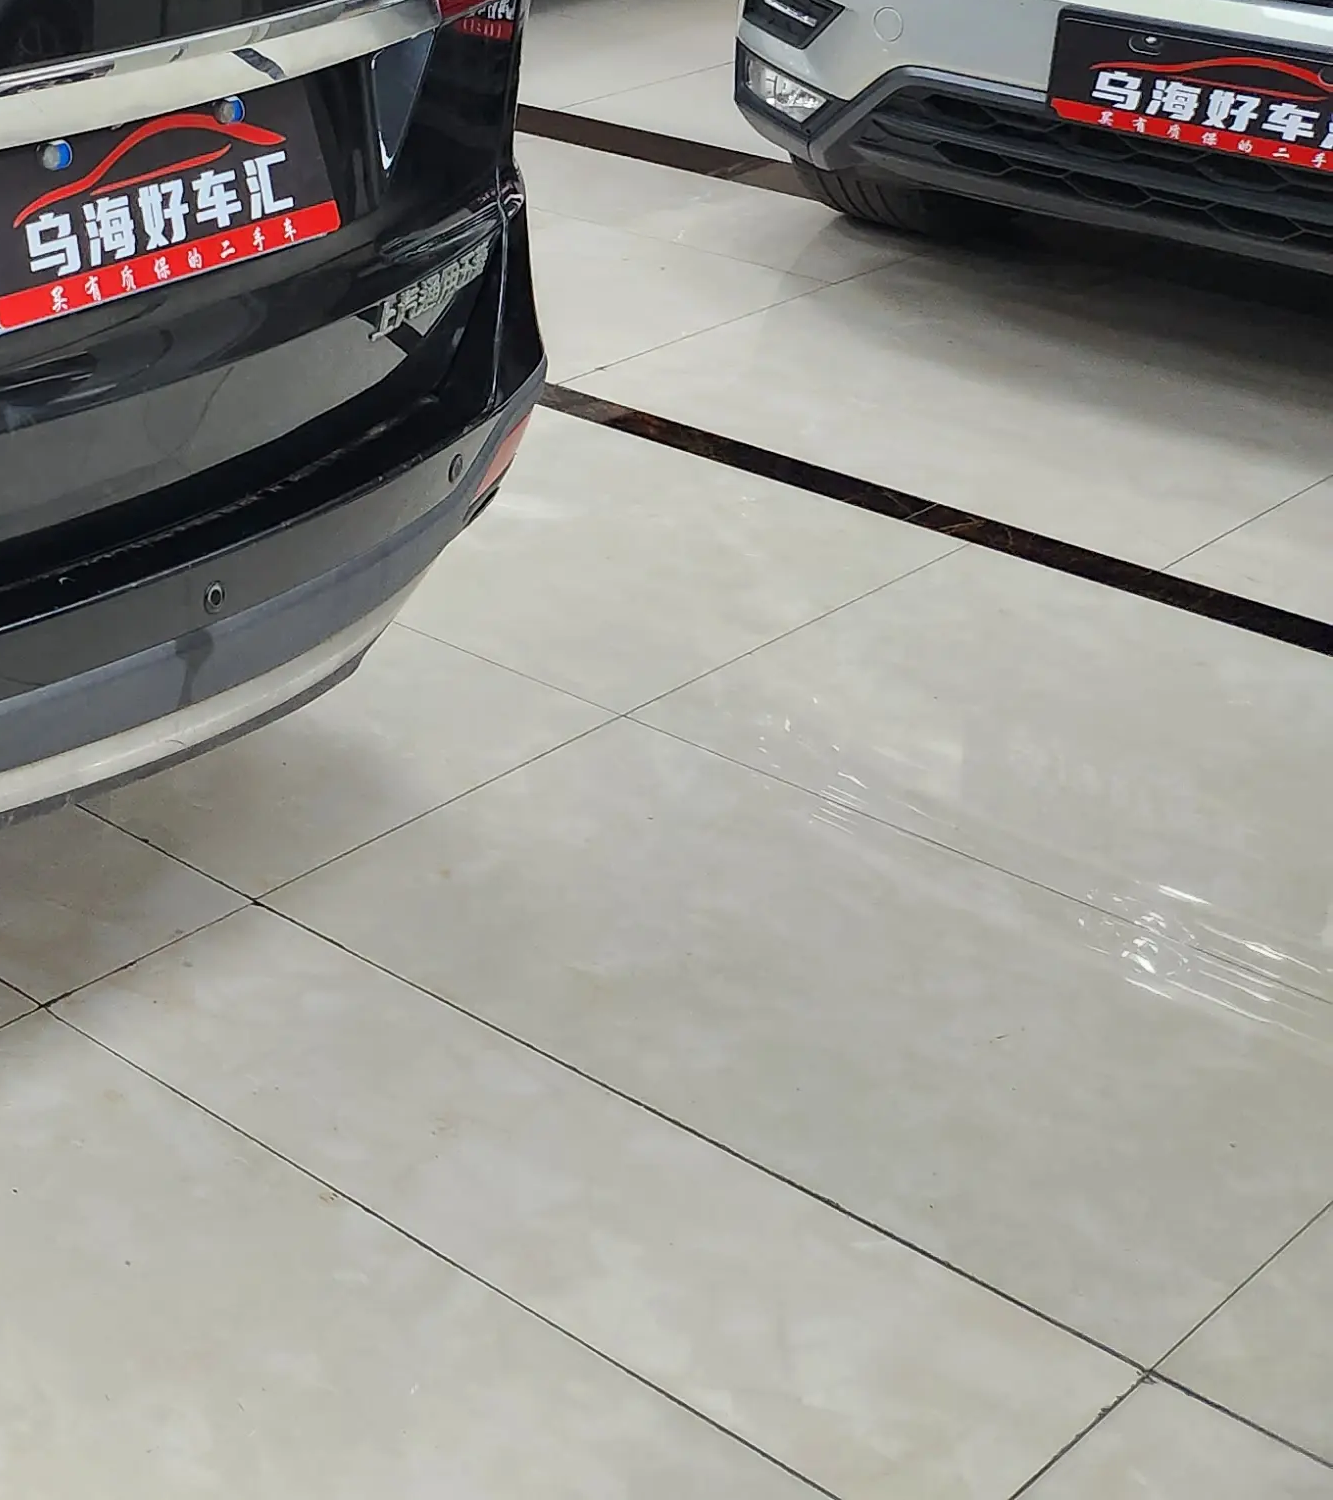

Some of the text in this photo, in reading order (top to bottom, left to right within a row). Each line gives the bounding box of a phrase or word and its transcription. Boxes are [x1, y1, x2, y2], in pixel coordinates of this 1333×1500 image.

[1091, 70, 1333, 149] 乌海好车
[24, 150, 295, 277] 乌海好车汇
[50, 217, 298, 313] 买有质保的二手车
